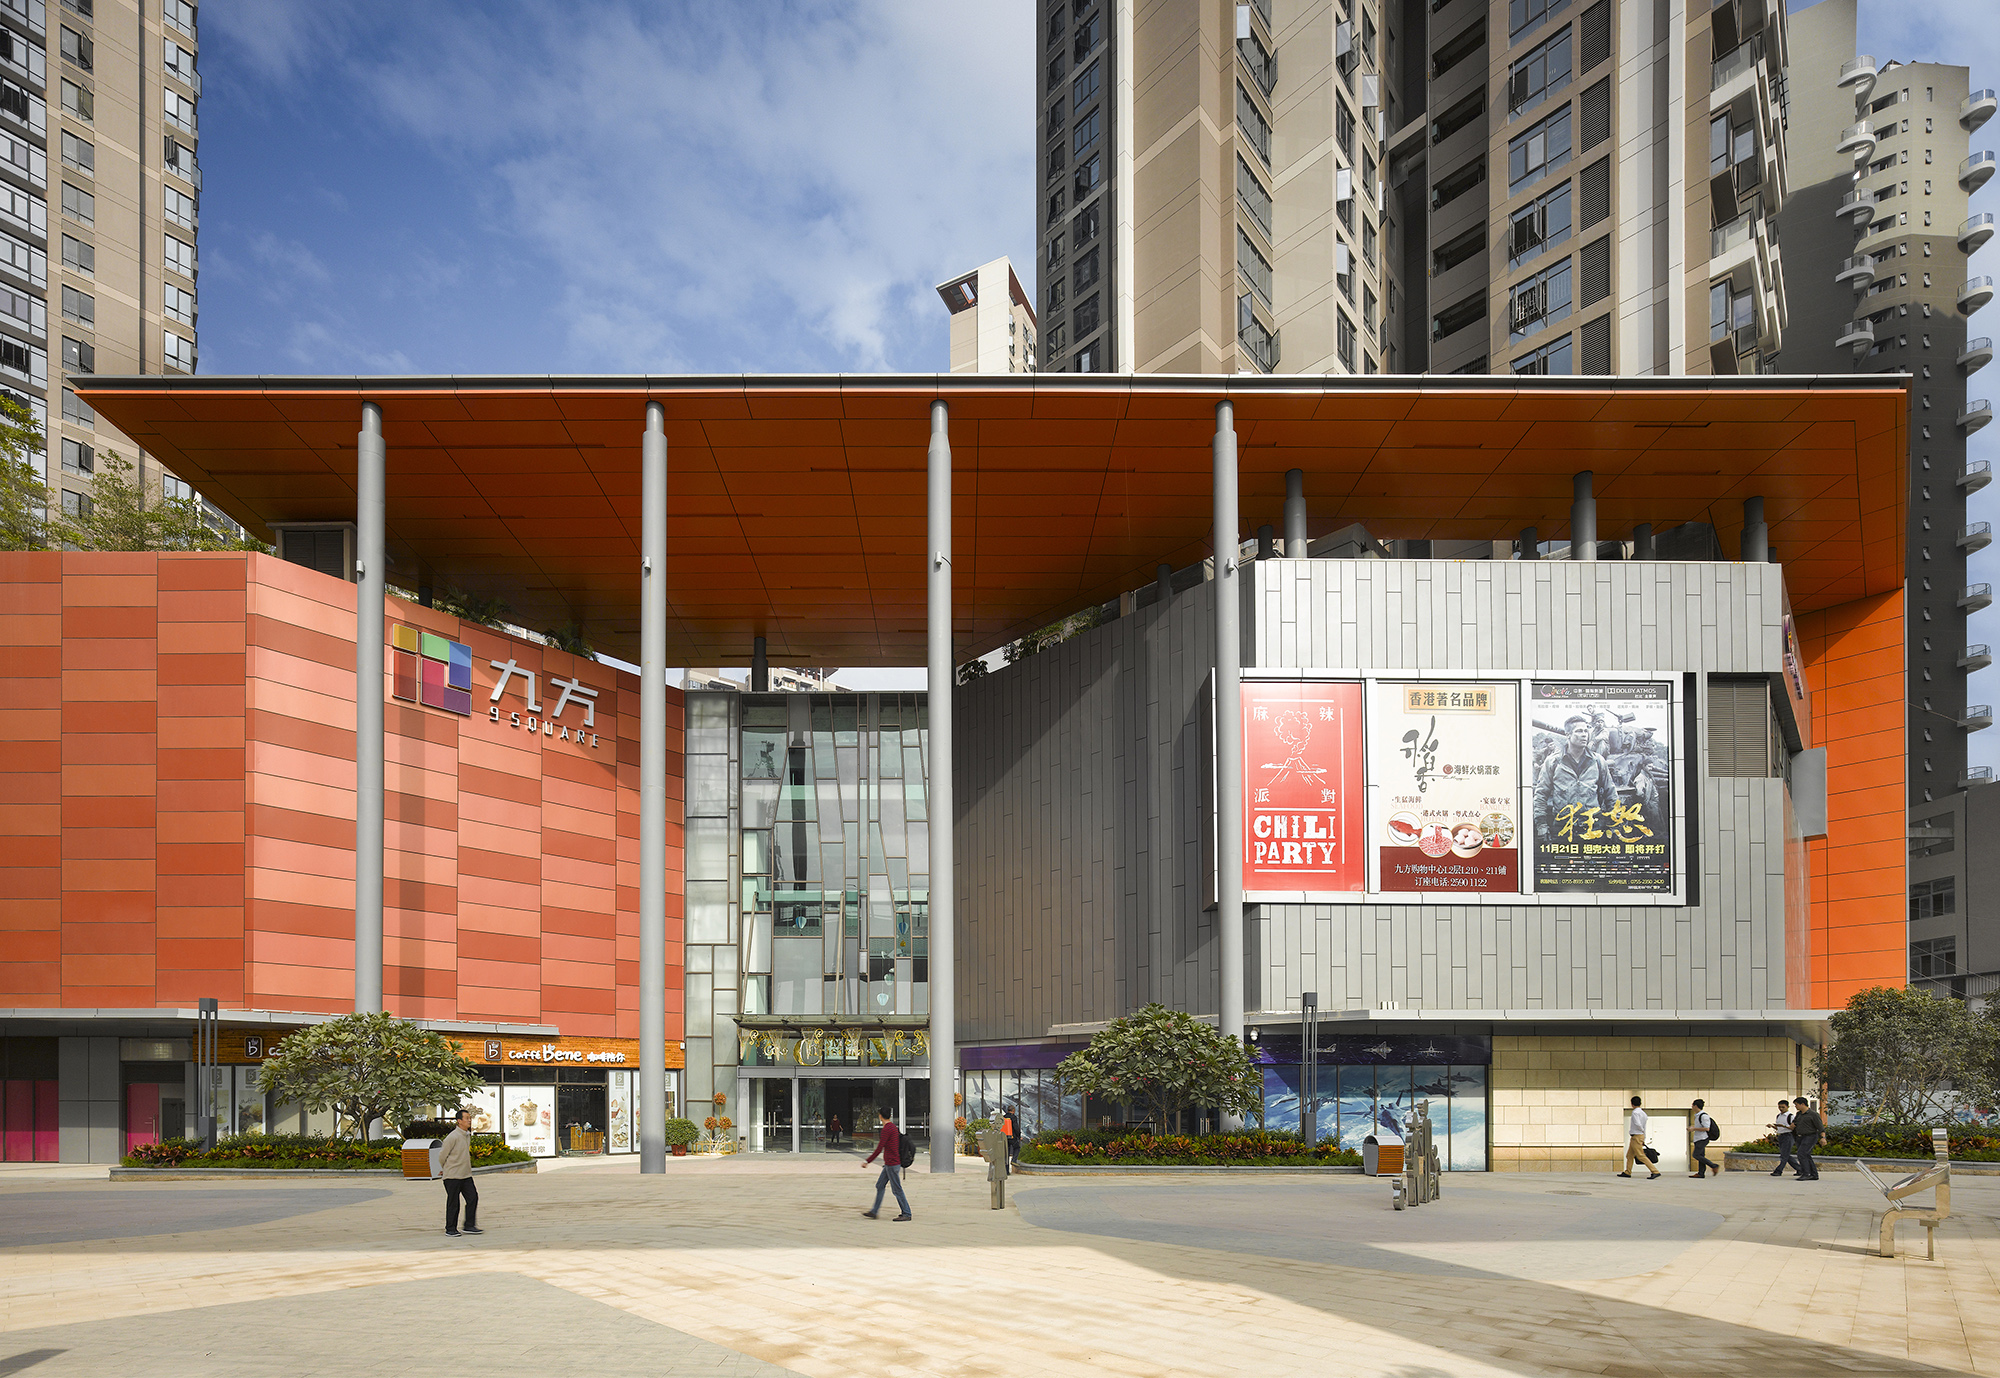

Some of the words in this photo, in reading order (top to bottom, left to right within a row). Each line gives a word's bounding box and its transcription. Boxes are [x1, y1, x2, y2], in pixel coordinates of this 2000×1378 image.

[490, 658, 598, 728] 九方
[1409, 691, 1488, 707] 香港著名品牌
[1253, 706, 1270, 721] 麻
[1319, 706, 1335, 722] 辣
[489, 706, 500, 721] 9
[510, 711, 600, 748] SQUARE
[1253, 788, 1271, 803] 派
[1321, 788, 1336, 804] 對
[1253, 815, 1336, 839] CHILI
[1555, 798, 1654, 843] 狂怒
[1254, 841, 1336, 864] PARTY
[1540, 844, 1579, 854] 11月21日
[1583, 844, 1622, 854] 坦克大战
[1625, 844, 1665, 855] 即将开打
[1470, 878, 1488, 888] 1122
